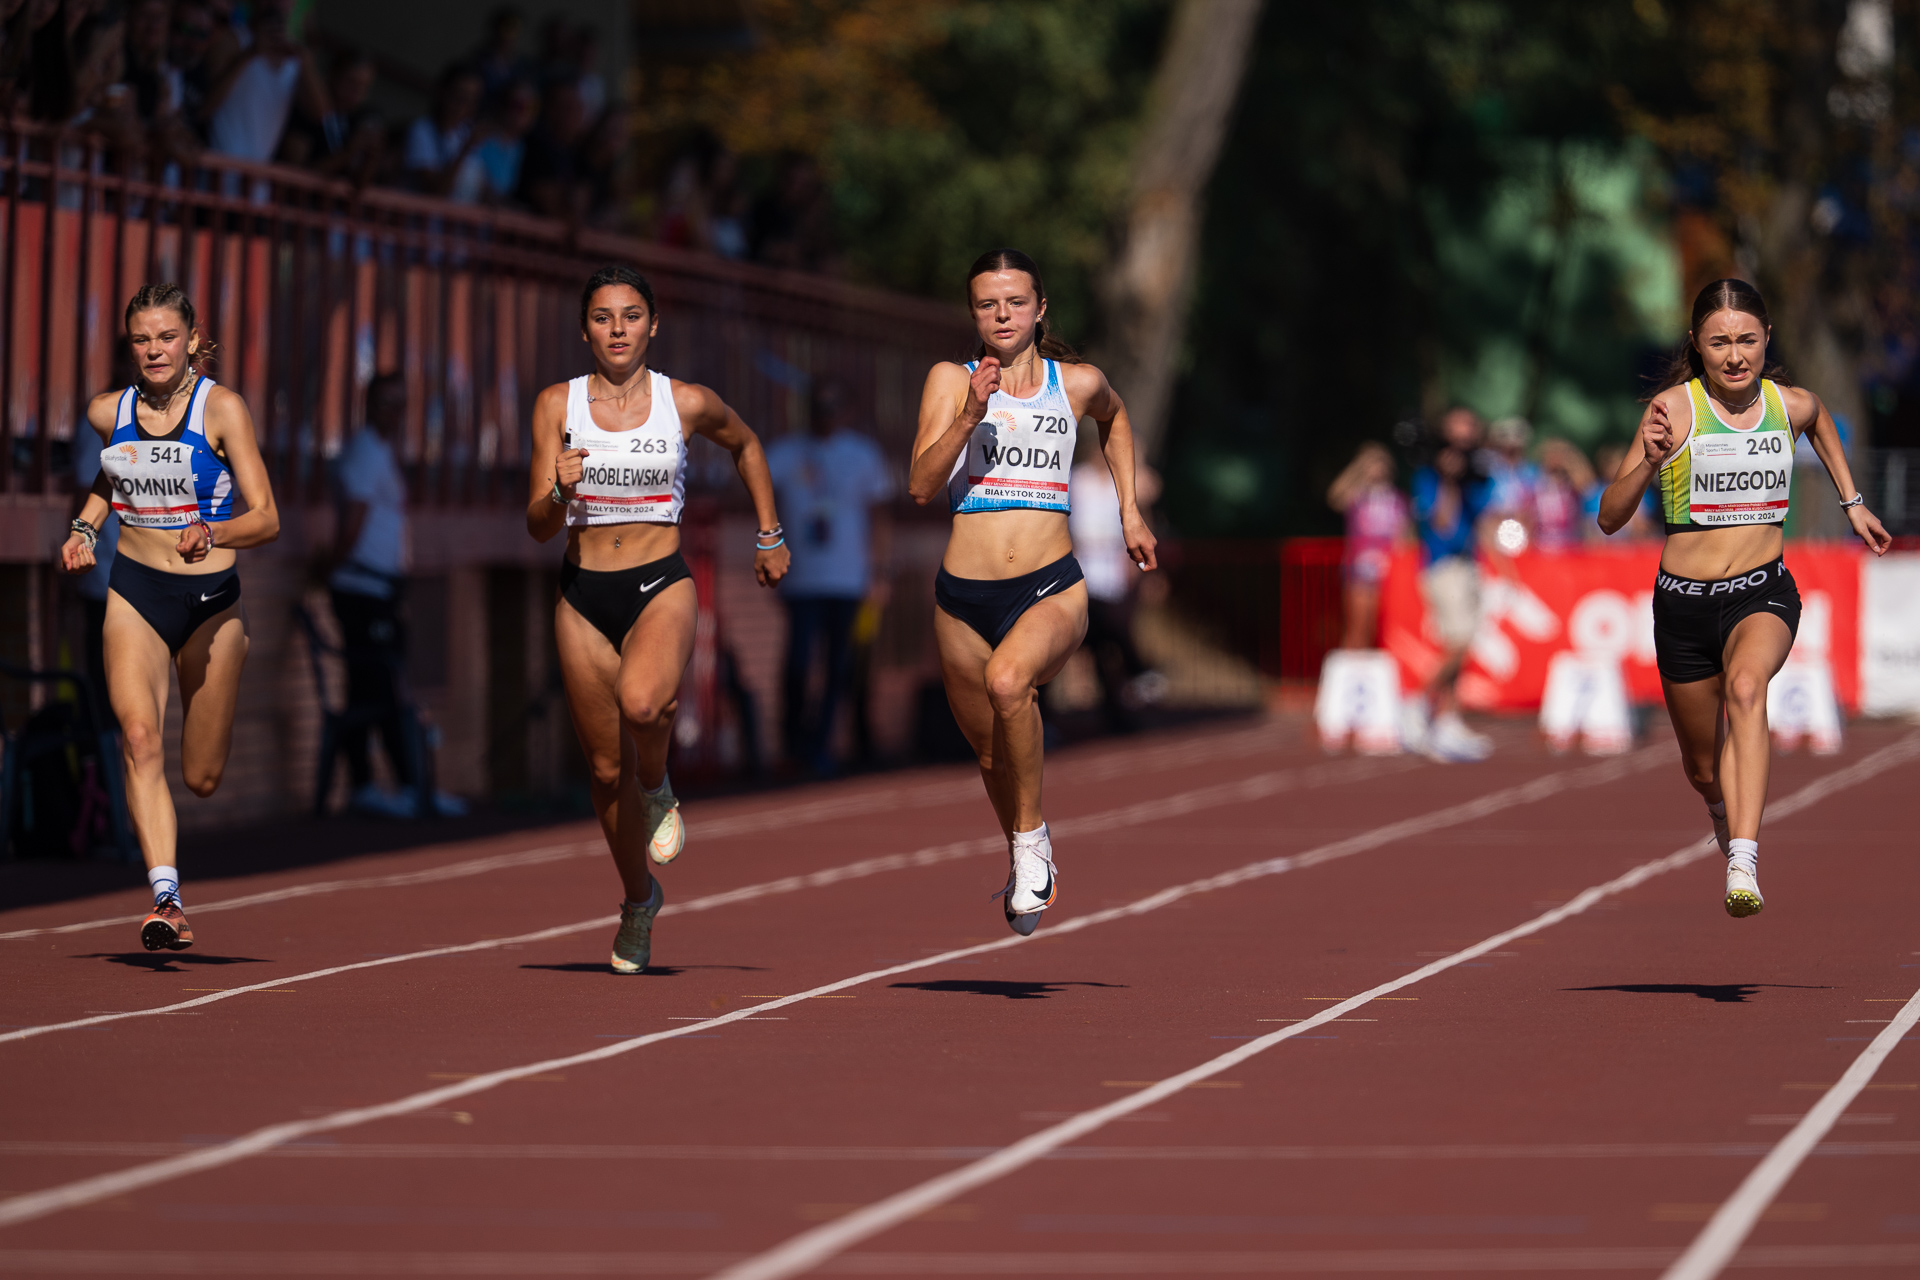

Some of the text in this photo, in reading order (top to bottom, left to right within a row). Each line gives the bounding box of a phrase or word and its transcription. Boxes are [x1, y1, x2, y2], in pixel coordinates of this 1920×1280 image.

[1032, 414, 1068, 435] 720
[630, 438, 667, 454] 263
[1746, 436, 1782, 455] 240
[150, 446, 182, 463] 541
[981, 444, 1061, 470] WOJDA
[1694, 469, 1787, 492] NIEZGODA
[985, 488, 1057, 500] BIAŁYSTOK 2024
[585, 504, 654, 514] BIAŁYSTOK 2024
[1707, 512, 1776, 522] BIAŁYSTOK 2024
[124, 514, 183, 524] BIAŁYSTOK 2024
[1656, 569, 1768, 596] NIKE PRO
